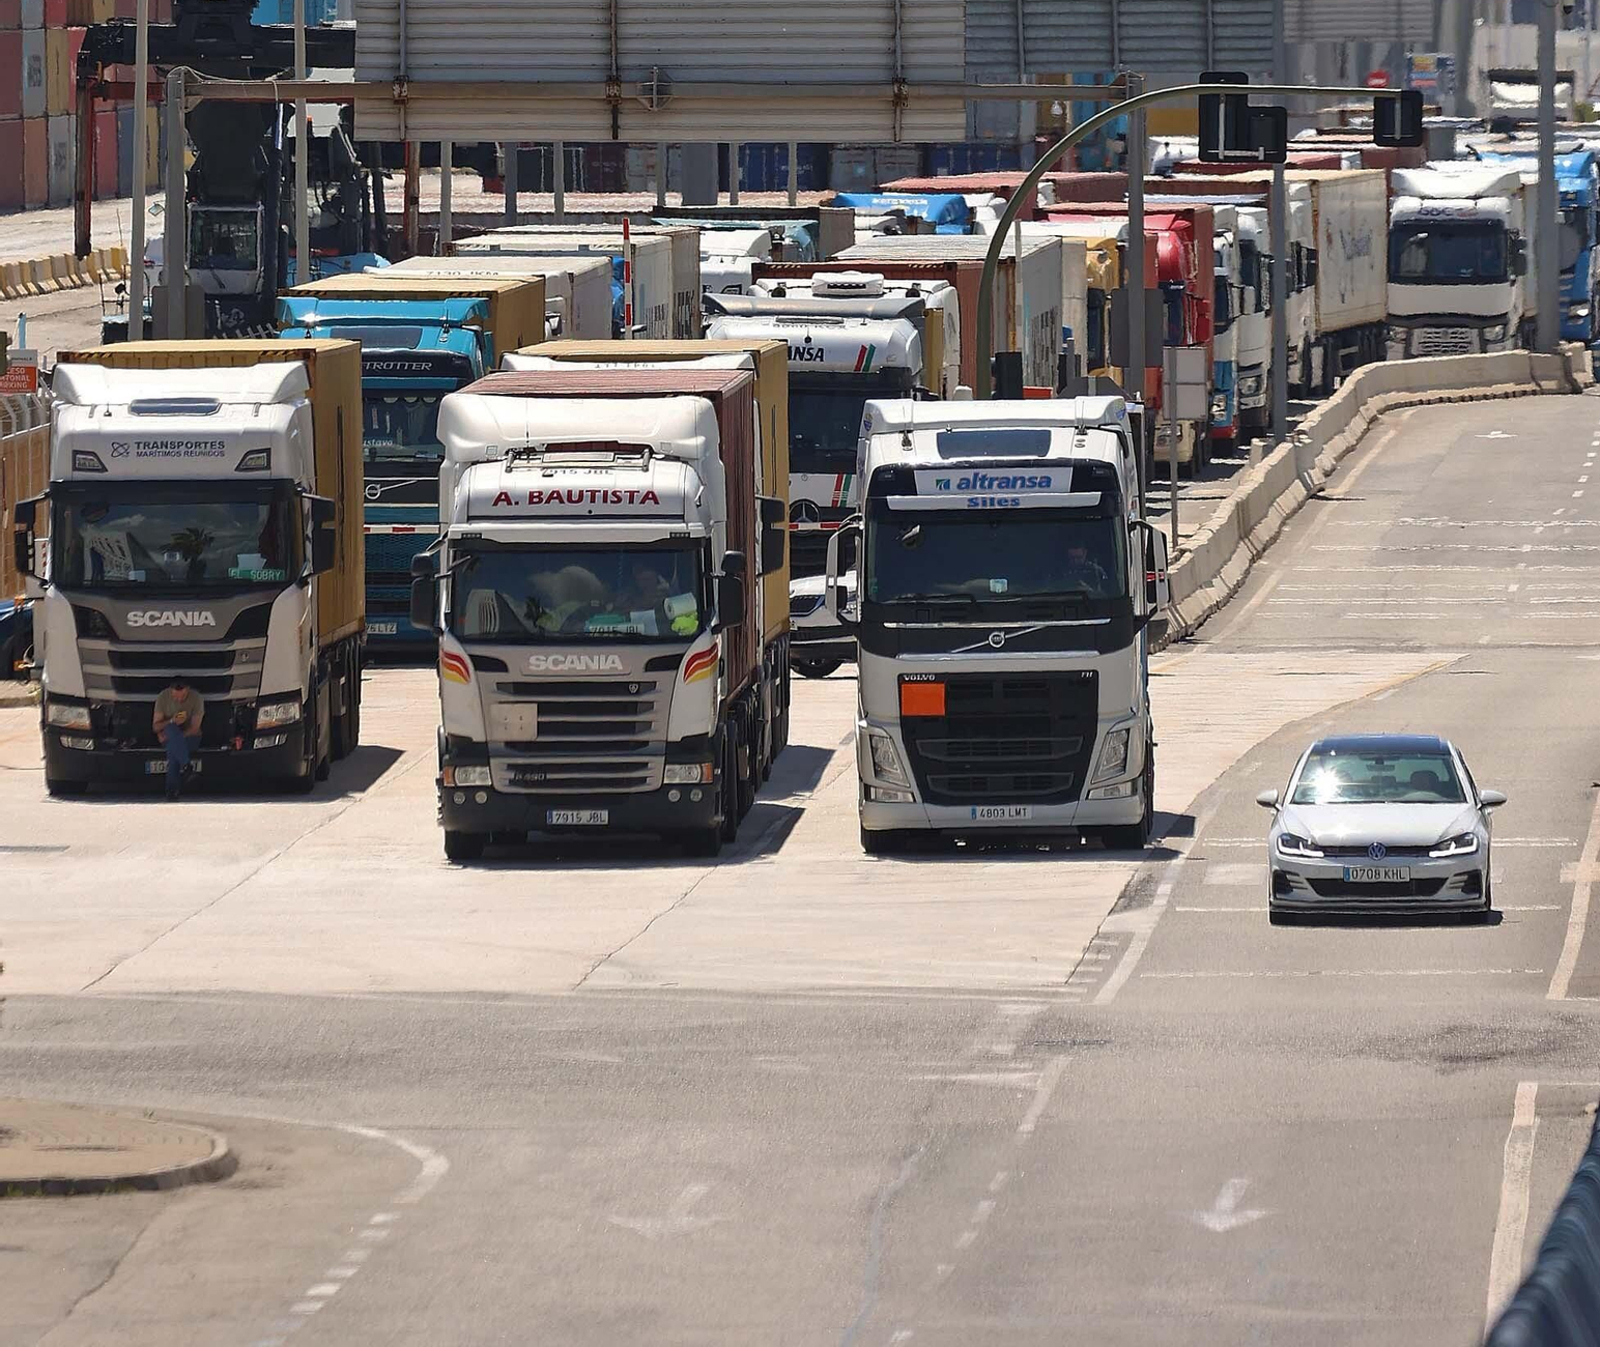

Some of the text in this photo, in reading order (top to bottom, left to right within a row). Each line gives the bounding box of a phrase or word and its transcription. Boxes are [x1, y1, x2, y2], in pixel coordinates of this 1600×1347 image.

[135, 440, 225, 450] TRANSPORTES
[956, 472, 1052, 490] altransa
[492, 489, 661, 507] A. BAUTISTA
[967, 497, 1020, 508] Siles
[127, 611, 216, 627] SCANIA
[529, 654, 624, 671] SCANIA
[555, 813, 606, 823] 7915 JBL
[979, 808, 1027, 819] 4803 LMT
[1351, 869, 1406, 880] 0708 KHL
